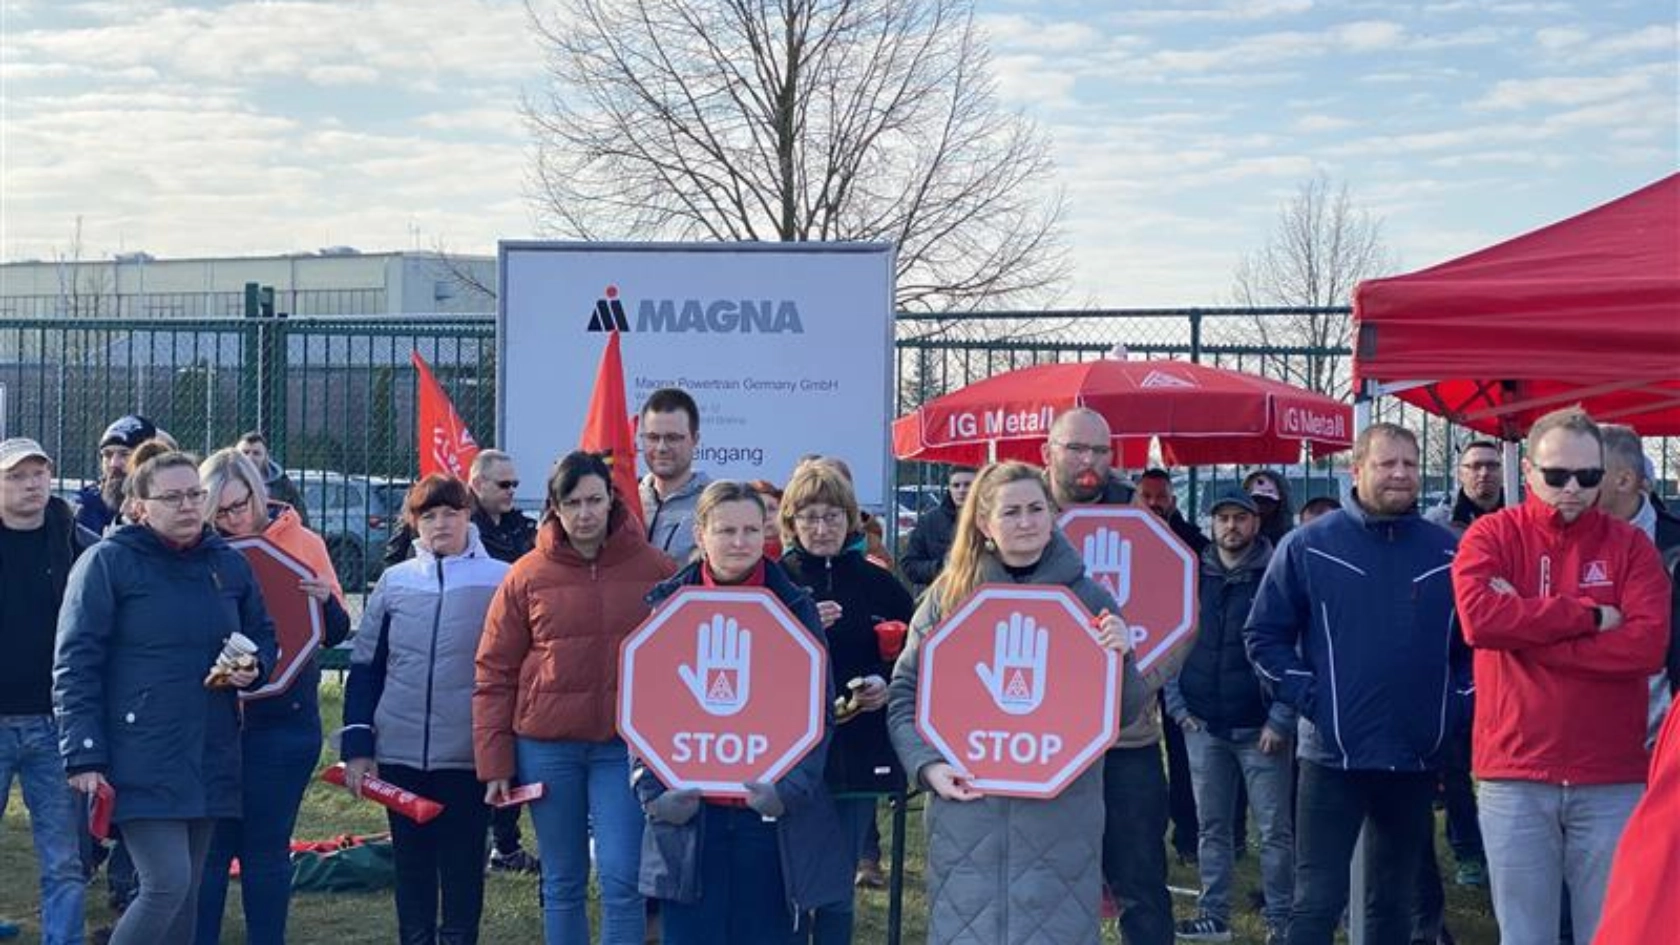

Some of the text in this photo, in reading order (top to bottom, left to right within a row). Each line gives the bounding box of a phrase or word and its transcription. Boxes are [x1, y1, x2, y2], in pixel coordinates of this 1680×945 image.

[636, 299, 804, 333] MAGNA
[635, 376, 839, 392] Magna Powertrain Germany GmbH
[949, 405, 1054, 438] IG Metall
[1283, 407, 1345, 438] IG Metall
[688, 442, 764, 465] eingang
[671, 732, 768, 765] STOP
[967, 730, 1063, 765] STOP
